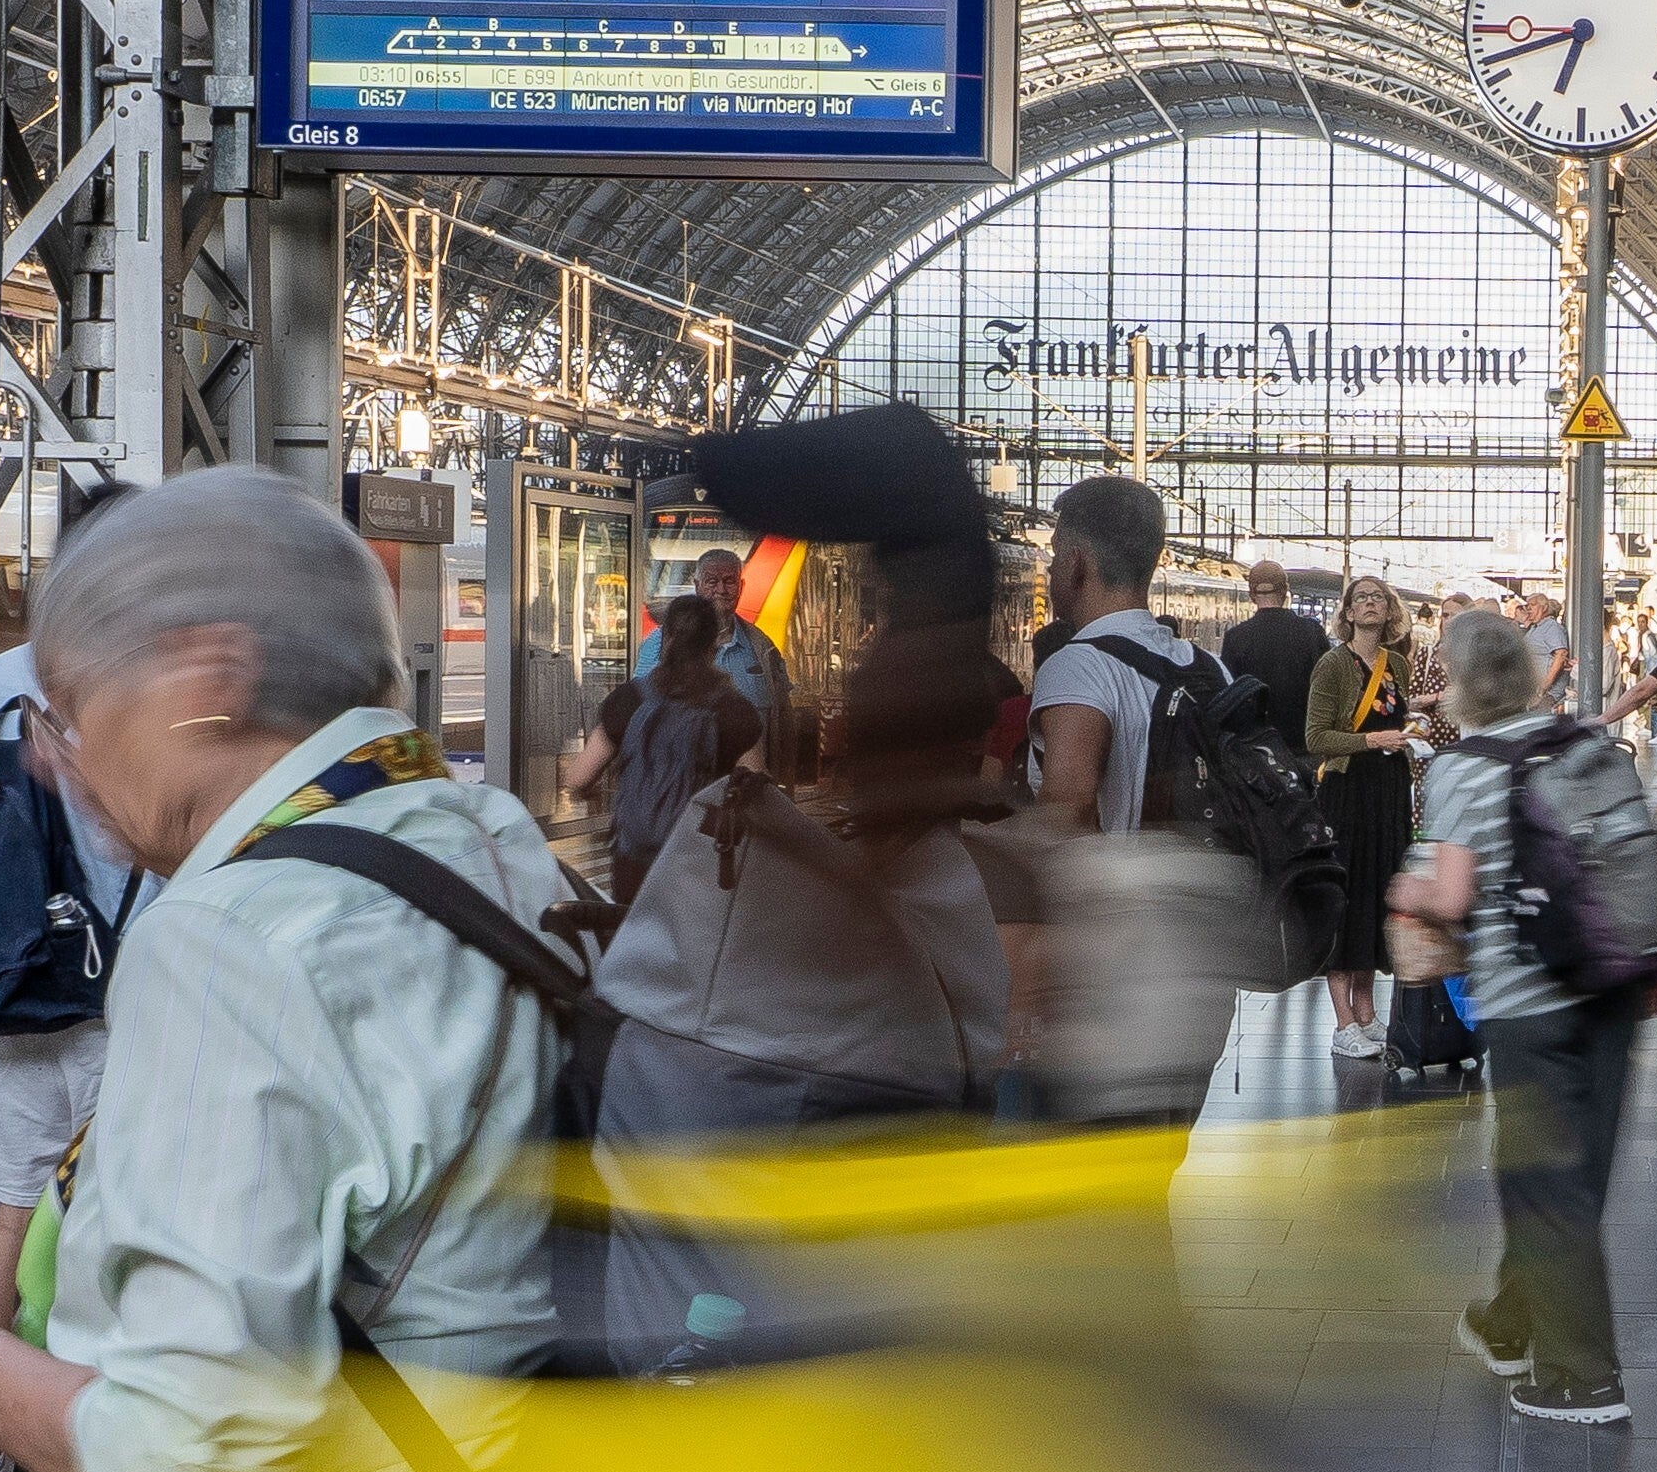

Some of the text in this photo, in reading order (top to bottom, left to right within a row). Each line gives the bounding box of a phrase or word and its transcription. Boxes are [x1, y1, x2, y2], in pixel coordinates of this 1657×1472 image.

[359, 66, 941, 92] 03:10 06:55 ICE 699 Ankunft von Bln Gesundbr. Gleis 6
[359, 90, 944, 117] 06:57 ICE 523 München Hbf via Nürnberg Hbf A-C
[288, 124, 359, 145] Gleis 8
[982, 319, 1528, 396] Frankfurter Allgemeine
[1042, 405, 1171, 424] ZEITUG
